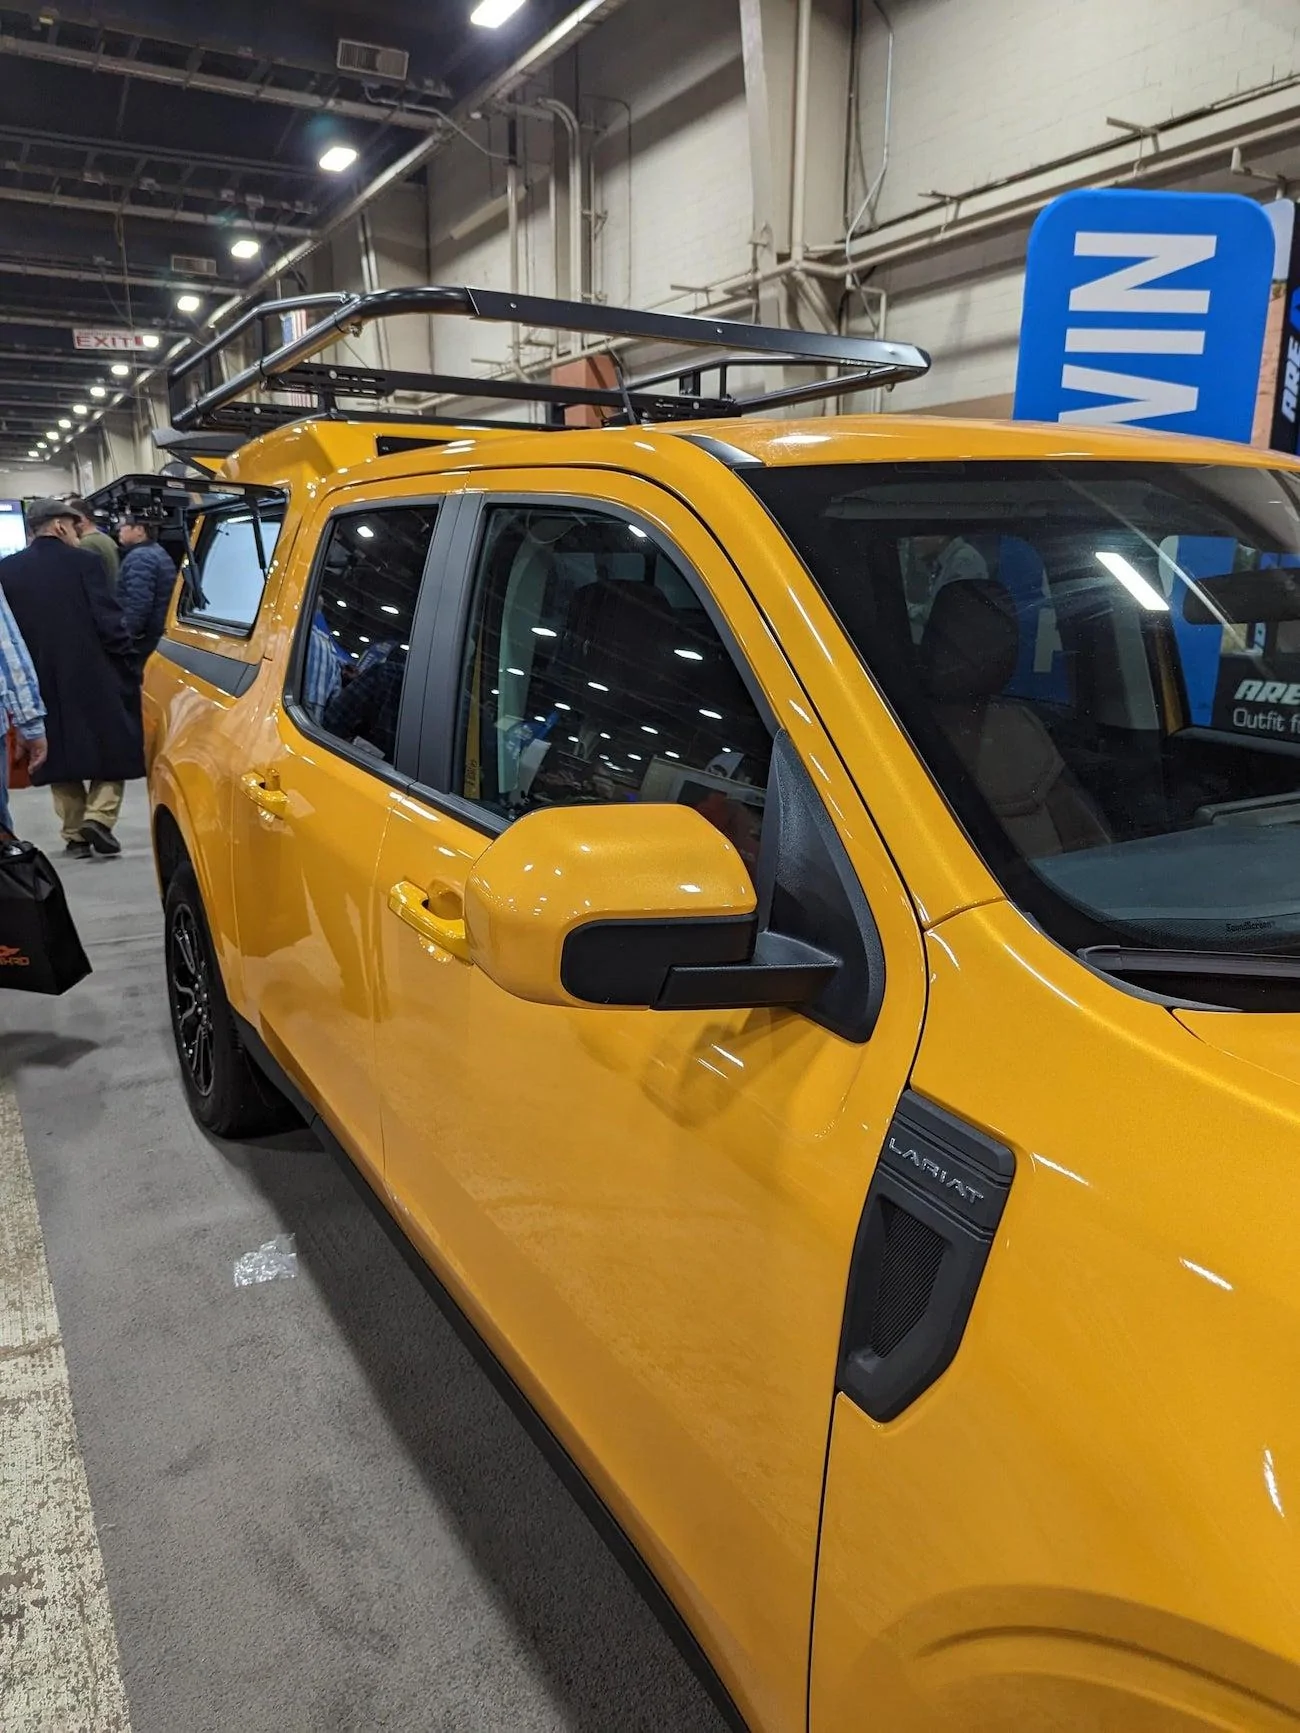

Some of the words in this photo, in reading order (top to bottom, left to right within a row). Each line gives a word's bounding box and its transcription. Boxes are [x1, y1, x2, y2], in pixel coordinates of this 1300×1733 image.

[76, 335, 132, 348] EXIT
[1234, 680, 1300, 705] ARE
[1233, 708, 1285, 732] Outfit
[889, 1138, 984, 1204] LARIAT
